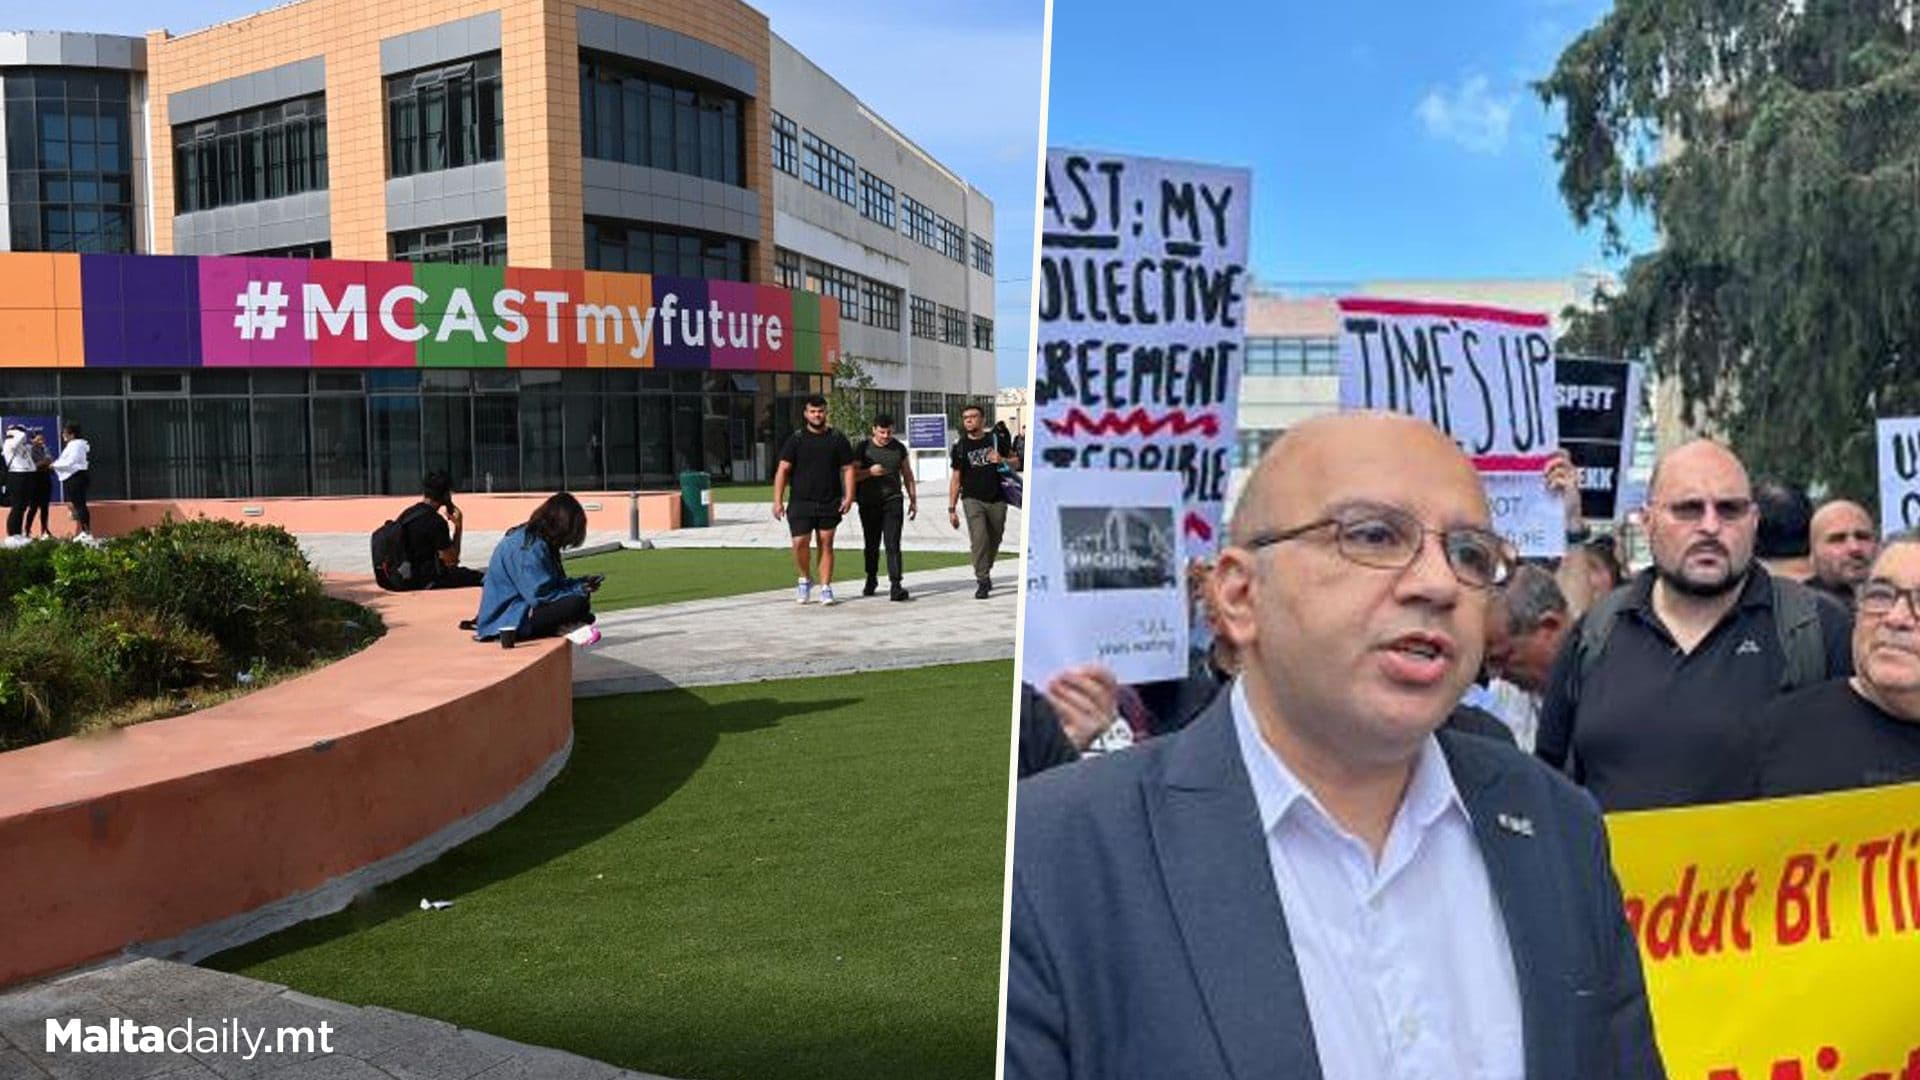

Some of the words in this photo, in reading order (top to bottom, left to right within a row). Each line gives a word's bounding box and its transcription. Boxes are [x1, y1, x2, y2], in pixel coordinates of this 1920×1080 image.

[1161, 179, 1233, 248] MY
[234, 281, 783, 359] #MCASTmyfuture
[1345, 318, 1494, 455] TIME'S
[1499, 333, 1550, 452] UP
